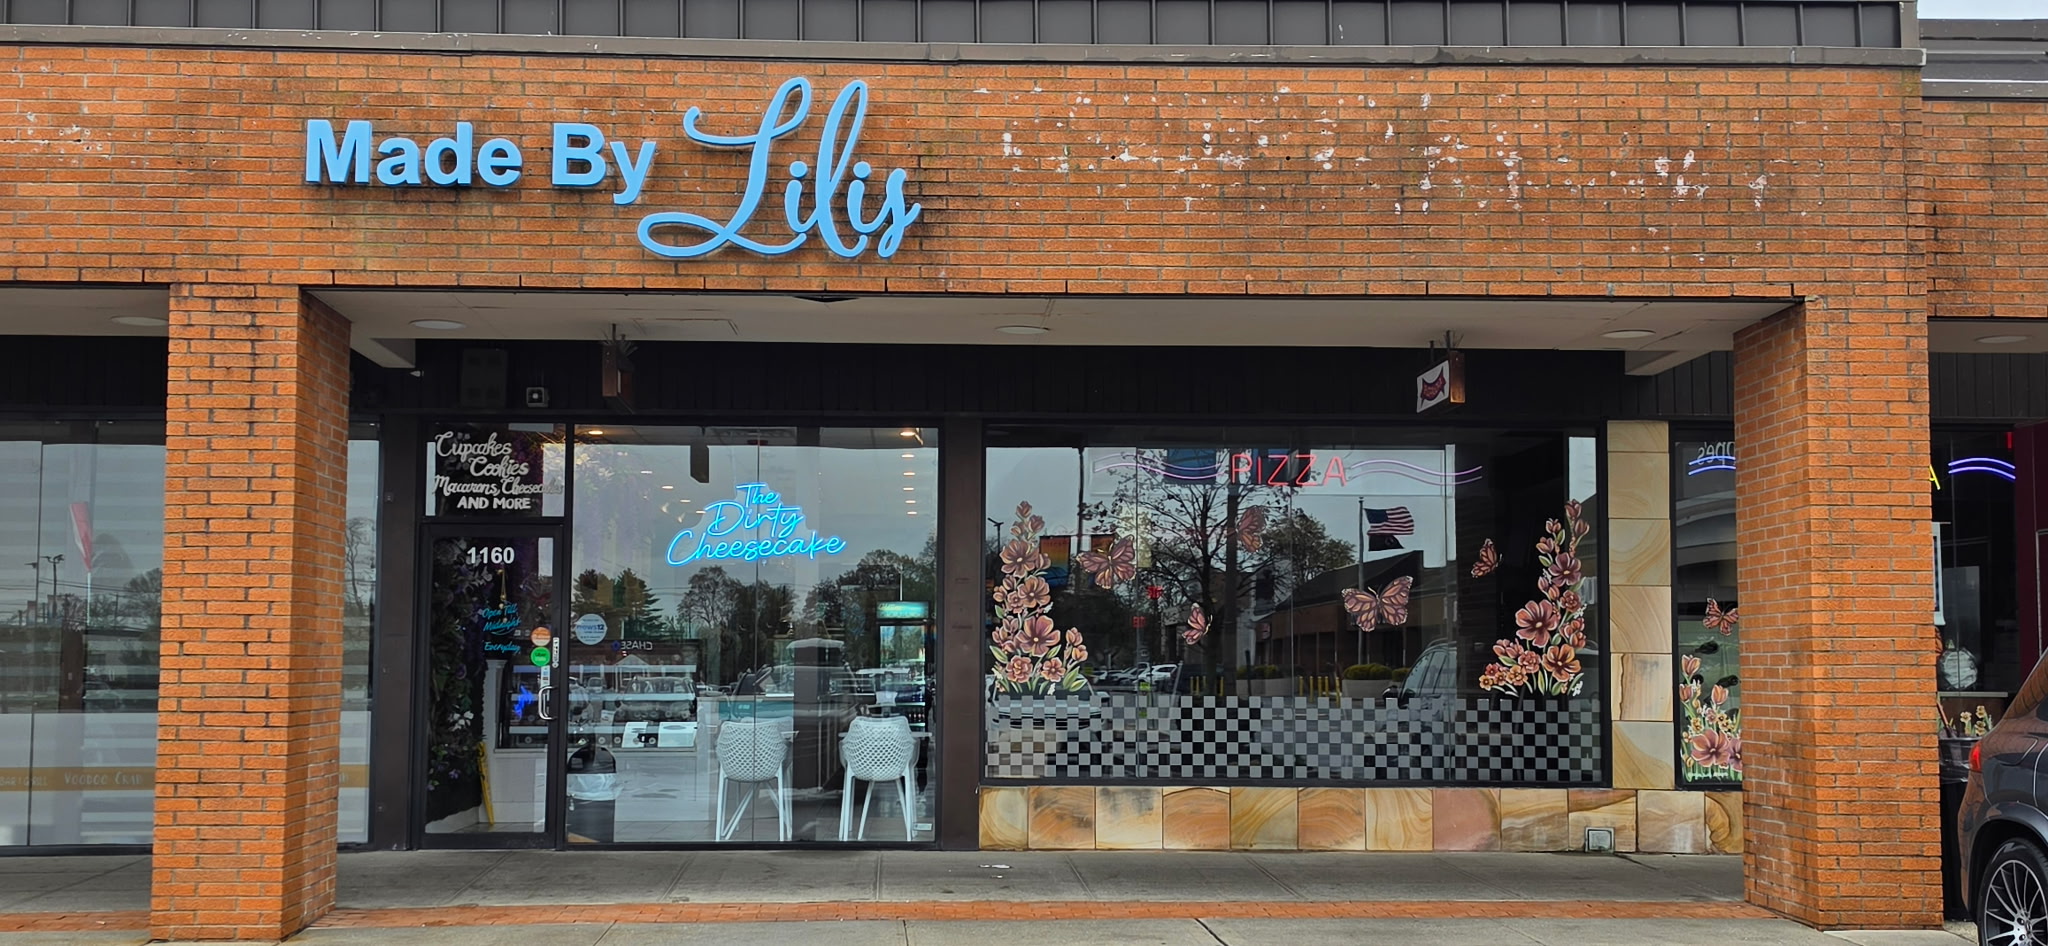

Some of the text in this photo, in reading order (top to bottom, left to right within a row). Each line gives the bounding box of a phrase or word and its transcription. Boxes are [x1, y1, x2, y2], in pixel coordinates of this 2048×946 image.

[305, 76, 922, 258] Made By Lilis
[435, 431, 513, 462] Cupcakes
[468, 456, 529, 478] Cookies
[1231, 453, 1349, 487] PIZZA
[457, 496, 531, 510] AND MORE
[736, 482, 780, 508] The
[704, 501, 804, 539] Dirty
[467, 547, 515, 564] 1160
[666, 530, 847, 567] Cheesecake
[484, 641, 520, 655] Everyday
